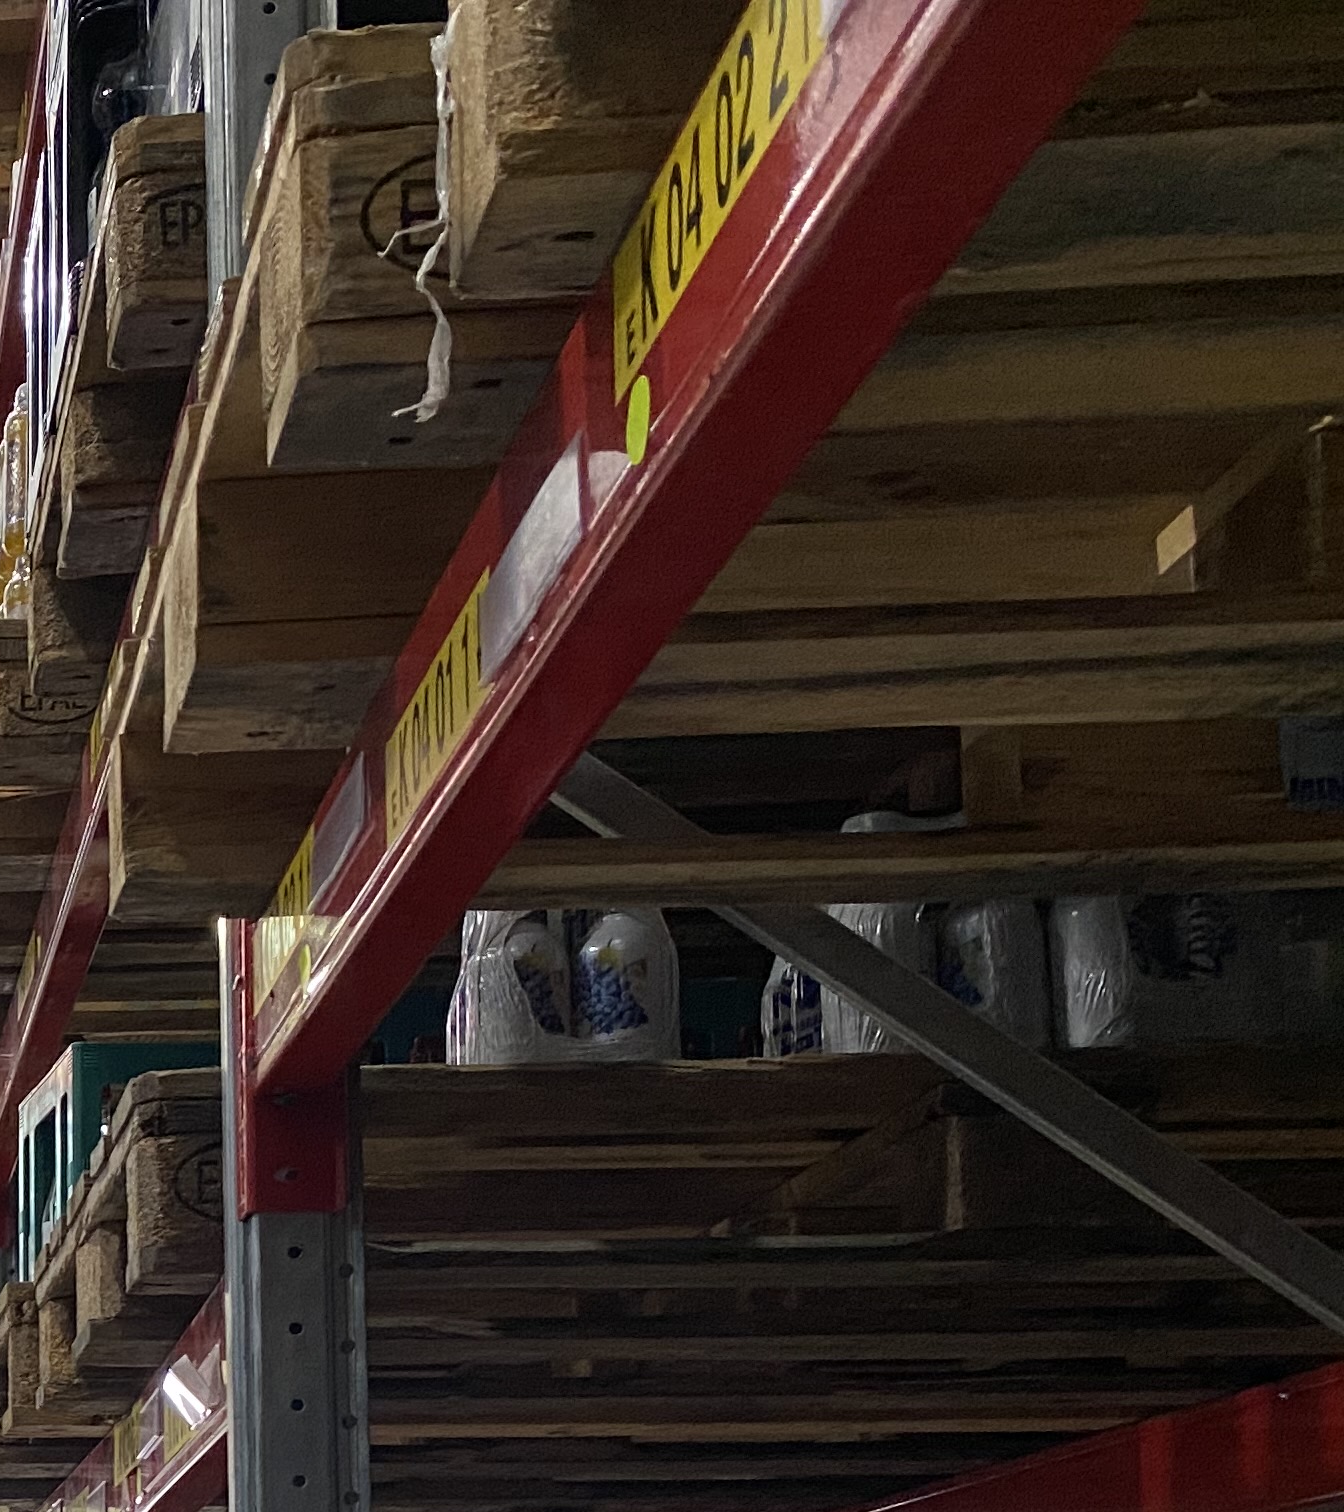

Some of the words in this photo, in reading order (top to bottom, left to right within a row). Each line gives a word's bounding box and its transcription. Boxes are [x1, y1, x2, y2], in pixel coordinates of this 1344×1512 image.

[160, 201, 203, 246] EP
[667, 123, 703, 292] 04
[715, 30, 755, 207] 02
